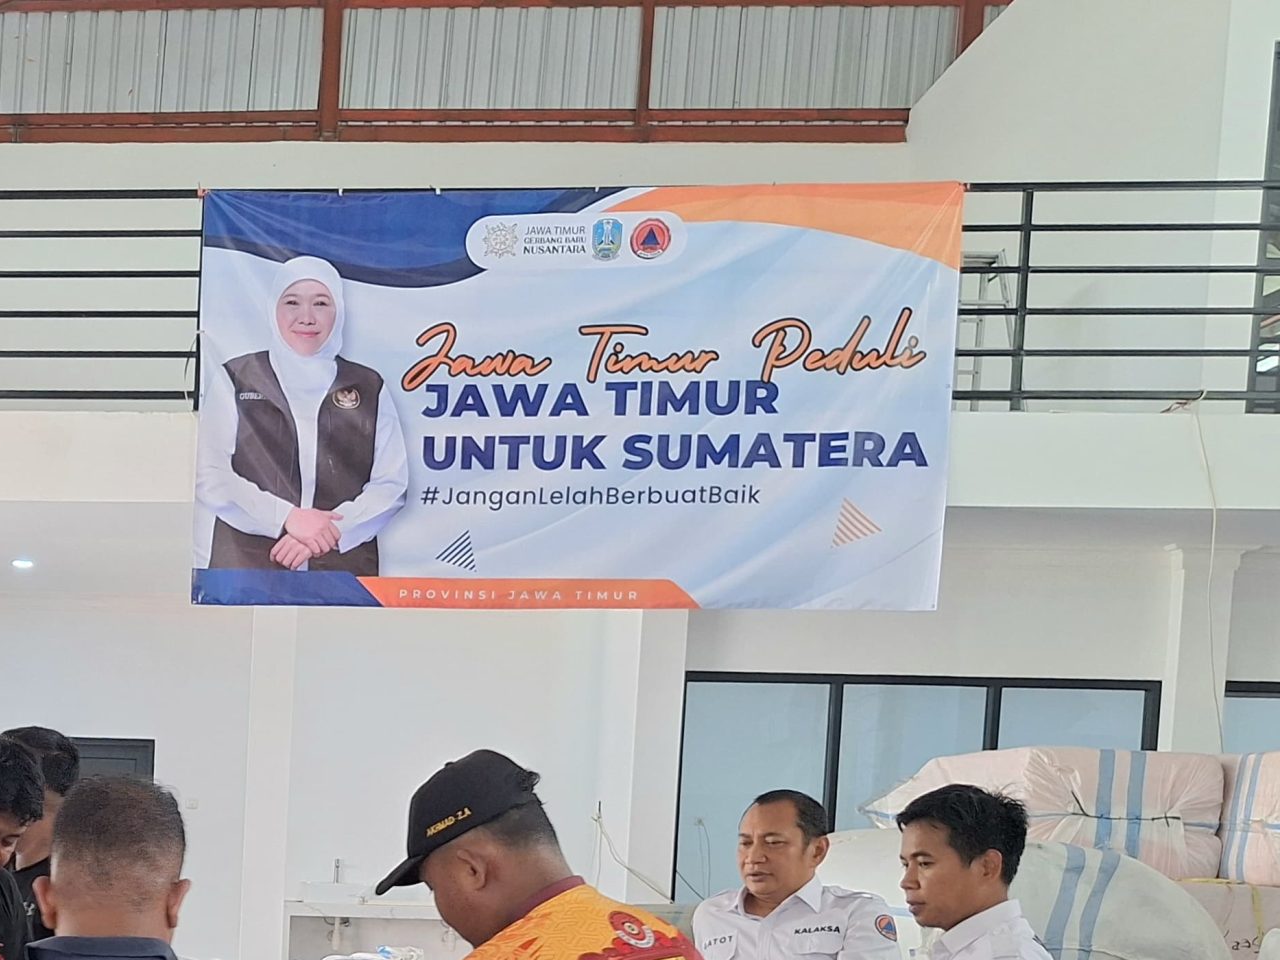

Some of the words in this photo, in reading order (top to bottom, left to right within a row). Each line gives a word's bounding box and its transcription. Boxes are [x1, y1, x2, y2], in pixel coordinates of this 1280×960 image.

[525, 226, 552, 235] JAWA
[554, 226, 585, 235] TIMUR
[523, 245, 586, 255] NUSANTARA
[402, 322, 551, 392] Jawa
[579, 324, 719, 383] Timur
[751, 307, 926, 382] Peduli
[421, 382, 589, 418] JAWA
[604, 380, 779, 416] TIMUR
[423, 434, 607, 471] UNTUK
[622, 431, 928, 470] SUMATERA
[421, 486, 761, 510] #JanganLelahBerbuatBaik
[399, 589, 496, 600] PROVINSI
[508, 590, 562, 600] JAWA
[575, 590, 638, 601] TIMUR
[794, 925, 841, 936] KALAKSA
